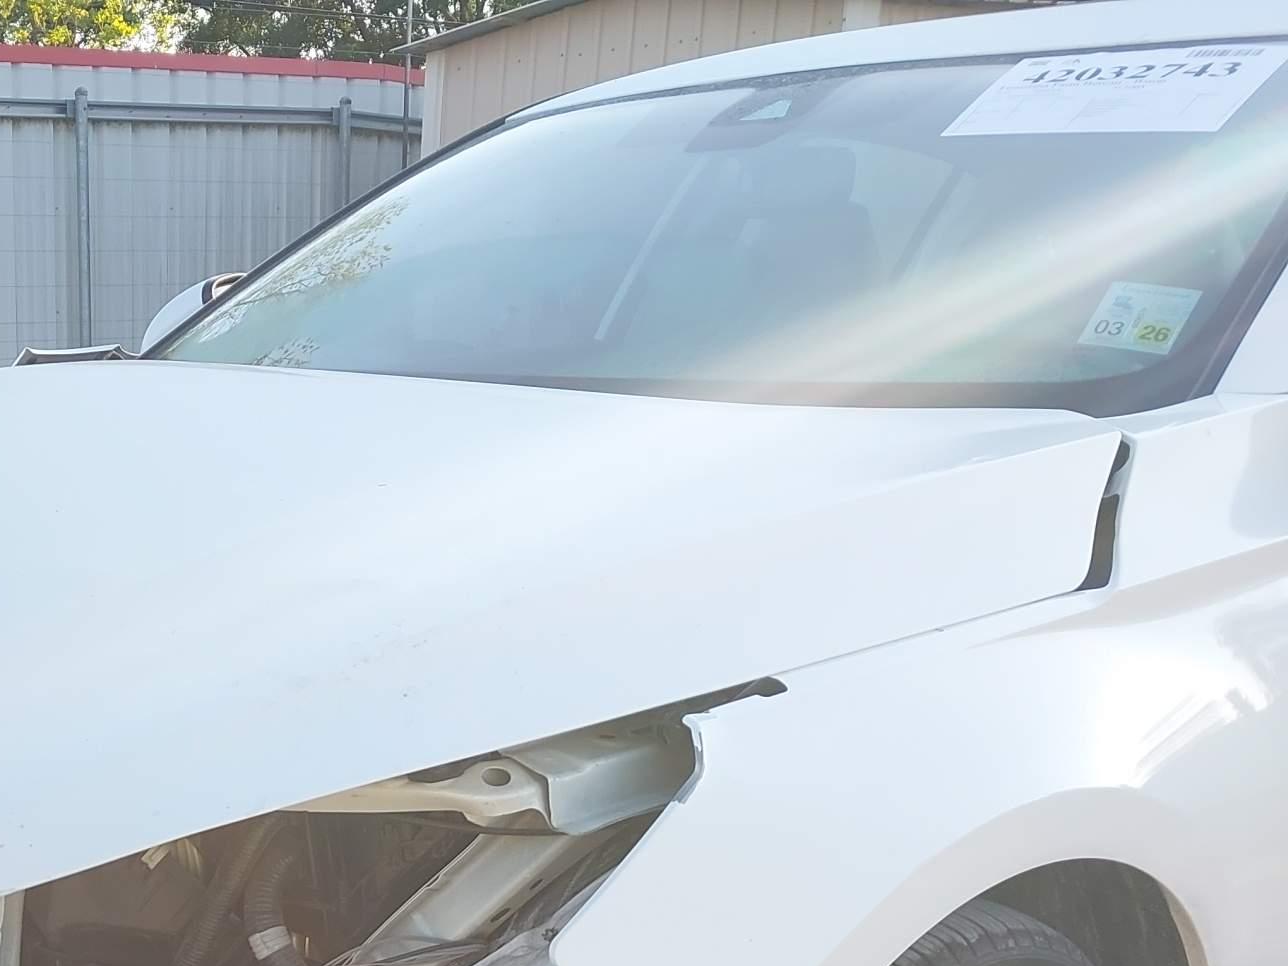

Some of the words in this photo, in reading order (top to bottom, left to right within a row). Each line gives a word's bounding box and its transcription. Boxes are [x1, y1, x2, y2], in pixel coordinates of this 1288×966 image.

[1023, 62, 1243, 84] 42032743
[1094, 319, 1124, 336] 03
[1138, 325, 1171, 342] 26
